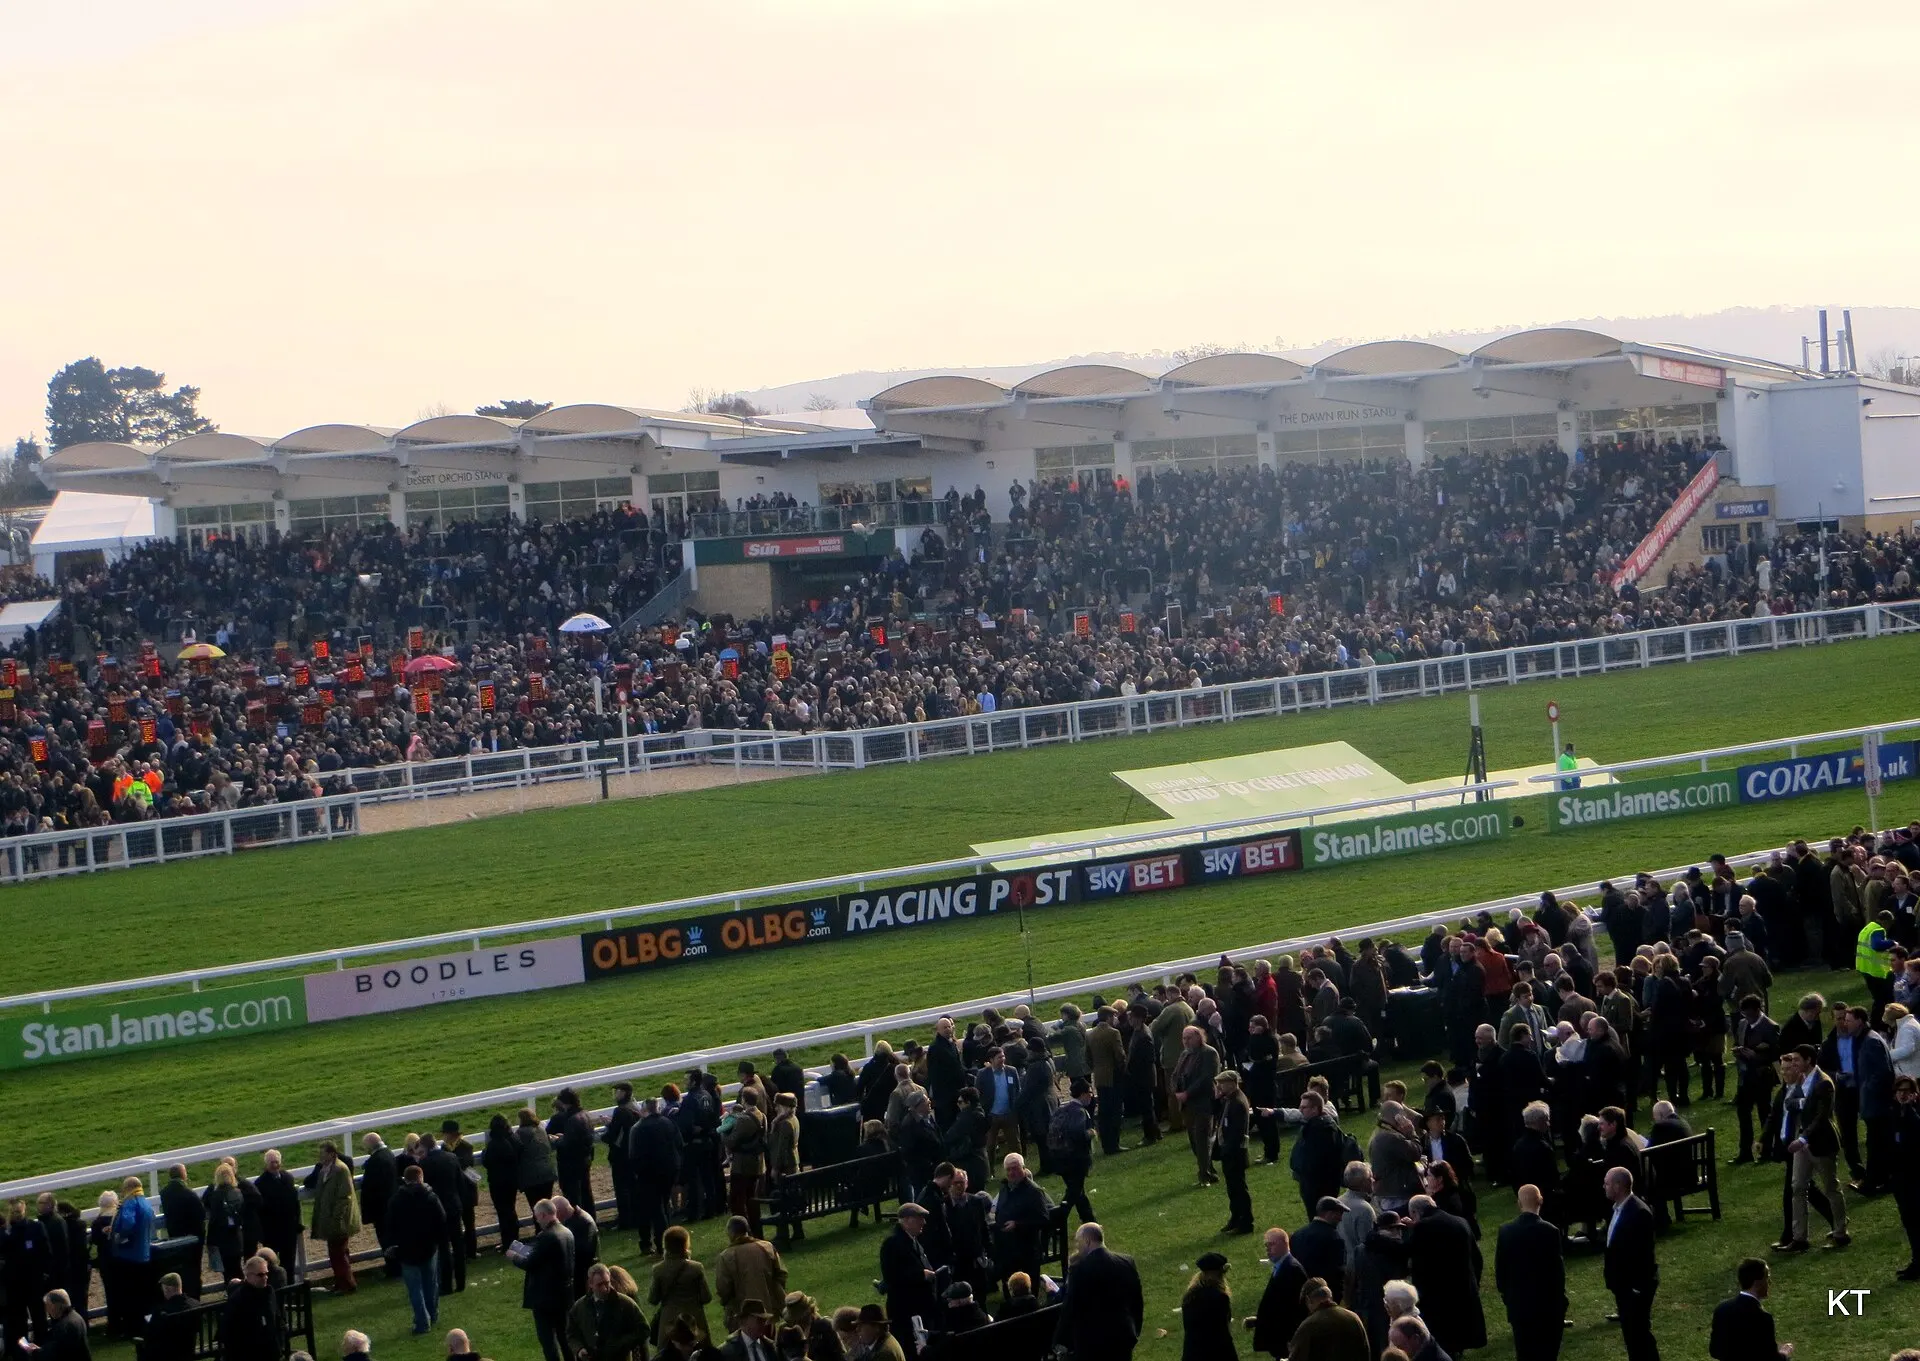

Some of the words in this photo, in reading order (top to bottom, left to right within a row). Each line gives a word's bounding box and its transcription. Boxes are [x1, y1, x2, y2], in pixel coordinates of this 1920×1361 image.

[1279, 413, 1298, 424] THE
[1301, 411, 1334, 424] DAWN
[1336, 409, 1360, 421] RUN
[1362, 407, 1397, 419] STAND
[406, 474, 436, 486] DESERT
[438, 472, 473, 483] ORCHID
[474, 470, 503, 480] STAND
[1747, 757, 1851, 798] CORAL
[1557, 782, 1731, 826] StanJames.com
[1245, 841, 1288, 869] BET
[1313, 813, 1500, 862] StanJames.com
[1134, 859, 1178, 887] BET
[847, 883, 977, 931] RACING
[989, 870, 1072, 911] PST
[356, 950, 536, 992] BOODLES
[431, 987, 466, 1000] 1798
[22, 995, 292, 1059] StanJames.com
